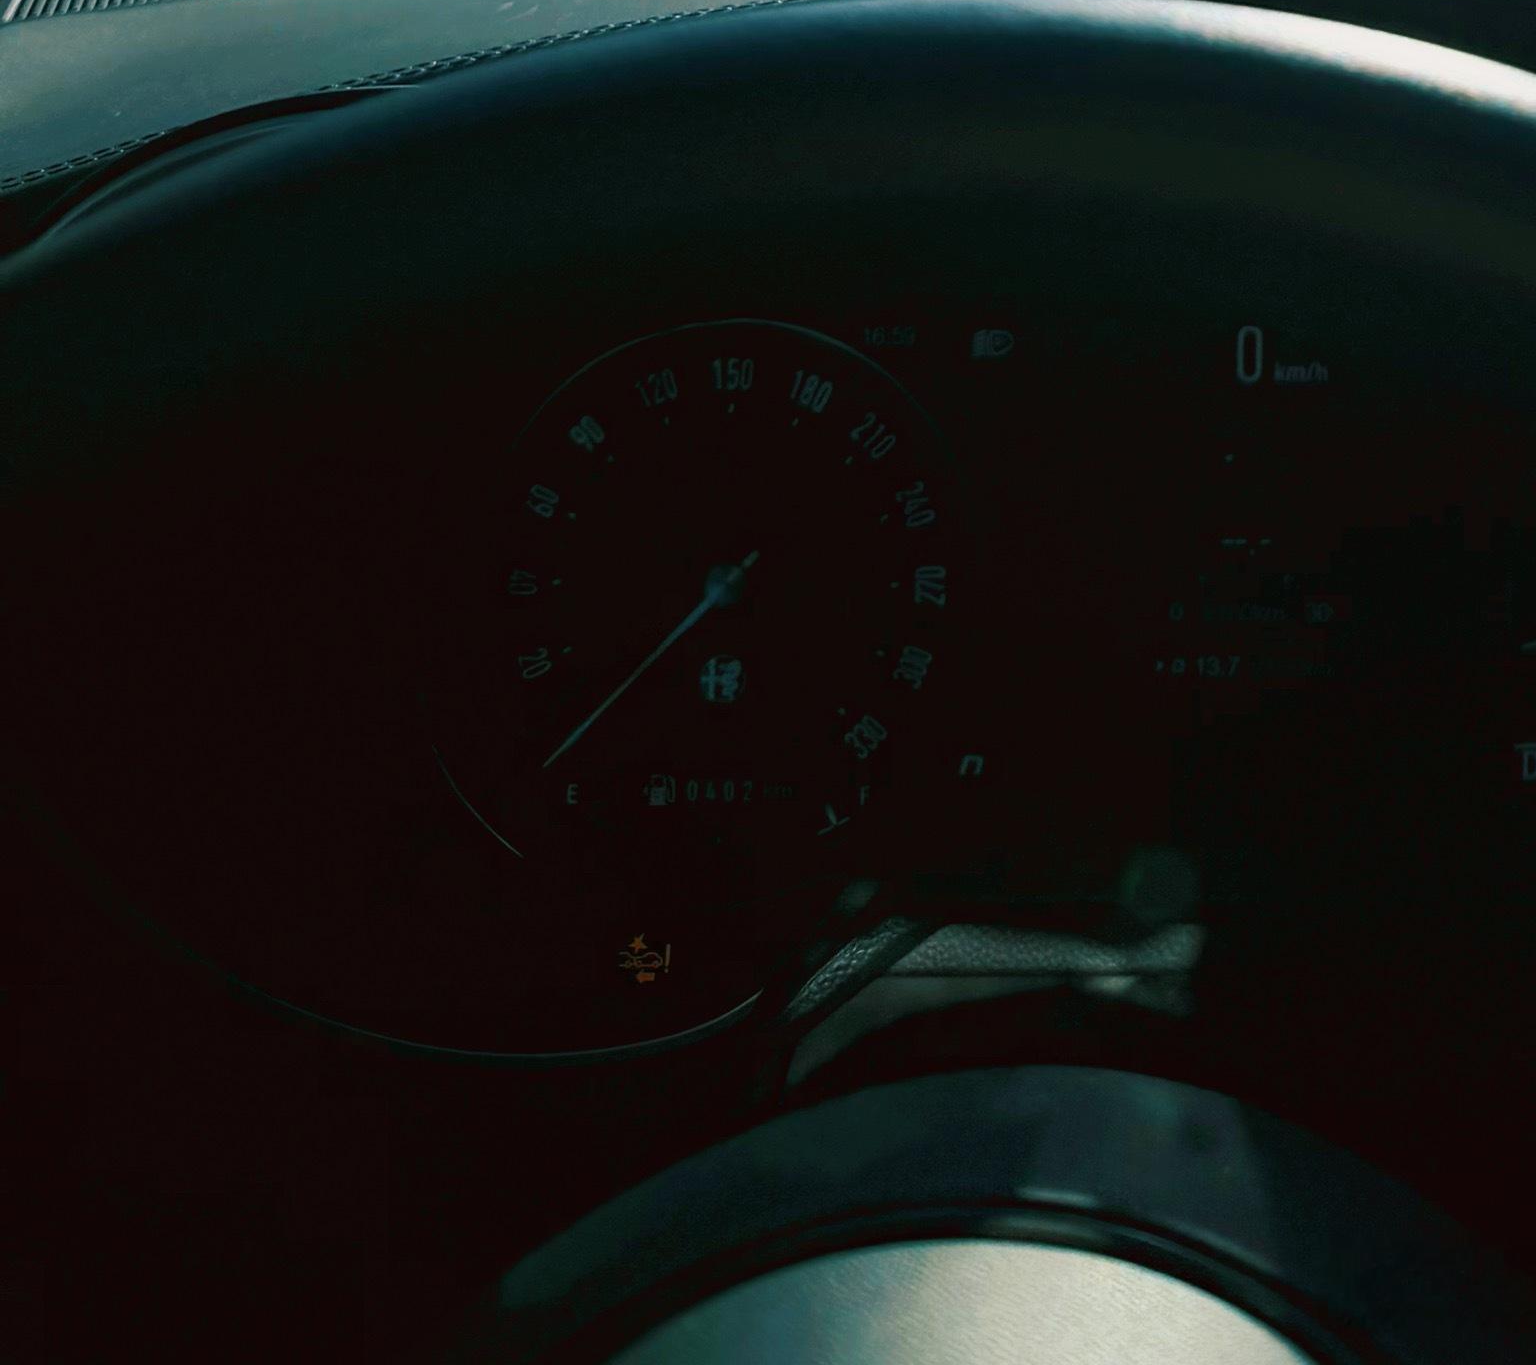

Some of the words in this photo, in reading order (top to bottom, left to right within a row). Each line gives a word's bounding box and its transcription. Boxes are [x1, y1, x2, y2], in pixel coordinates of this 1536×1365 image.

[711, 358, 755, 391] 150
[1236, 325, 1263, 383] 0
[634, 368, 679, 408] 120
[789, 369, 834, 413] 180
[568, 415, 606, 453] 90
[849, 411, 897, 461] 210
[526, 483, 560, 519] 60
[895, 480, 936, 529] 240
[914, 565, 947, 608] 270
[517, 647, 553, 681] 20
[892, 643, 933, 691] 300
[843, 714, 889, 761] 330
[566, 784, 578, 805] E
[860, 785, 871, 806] F
